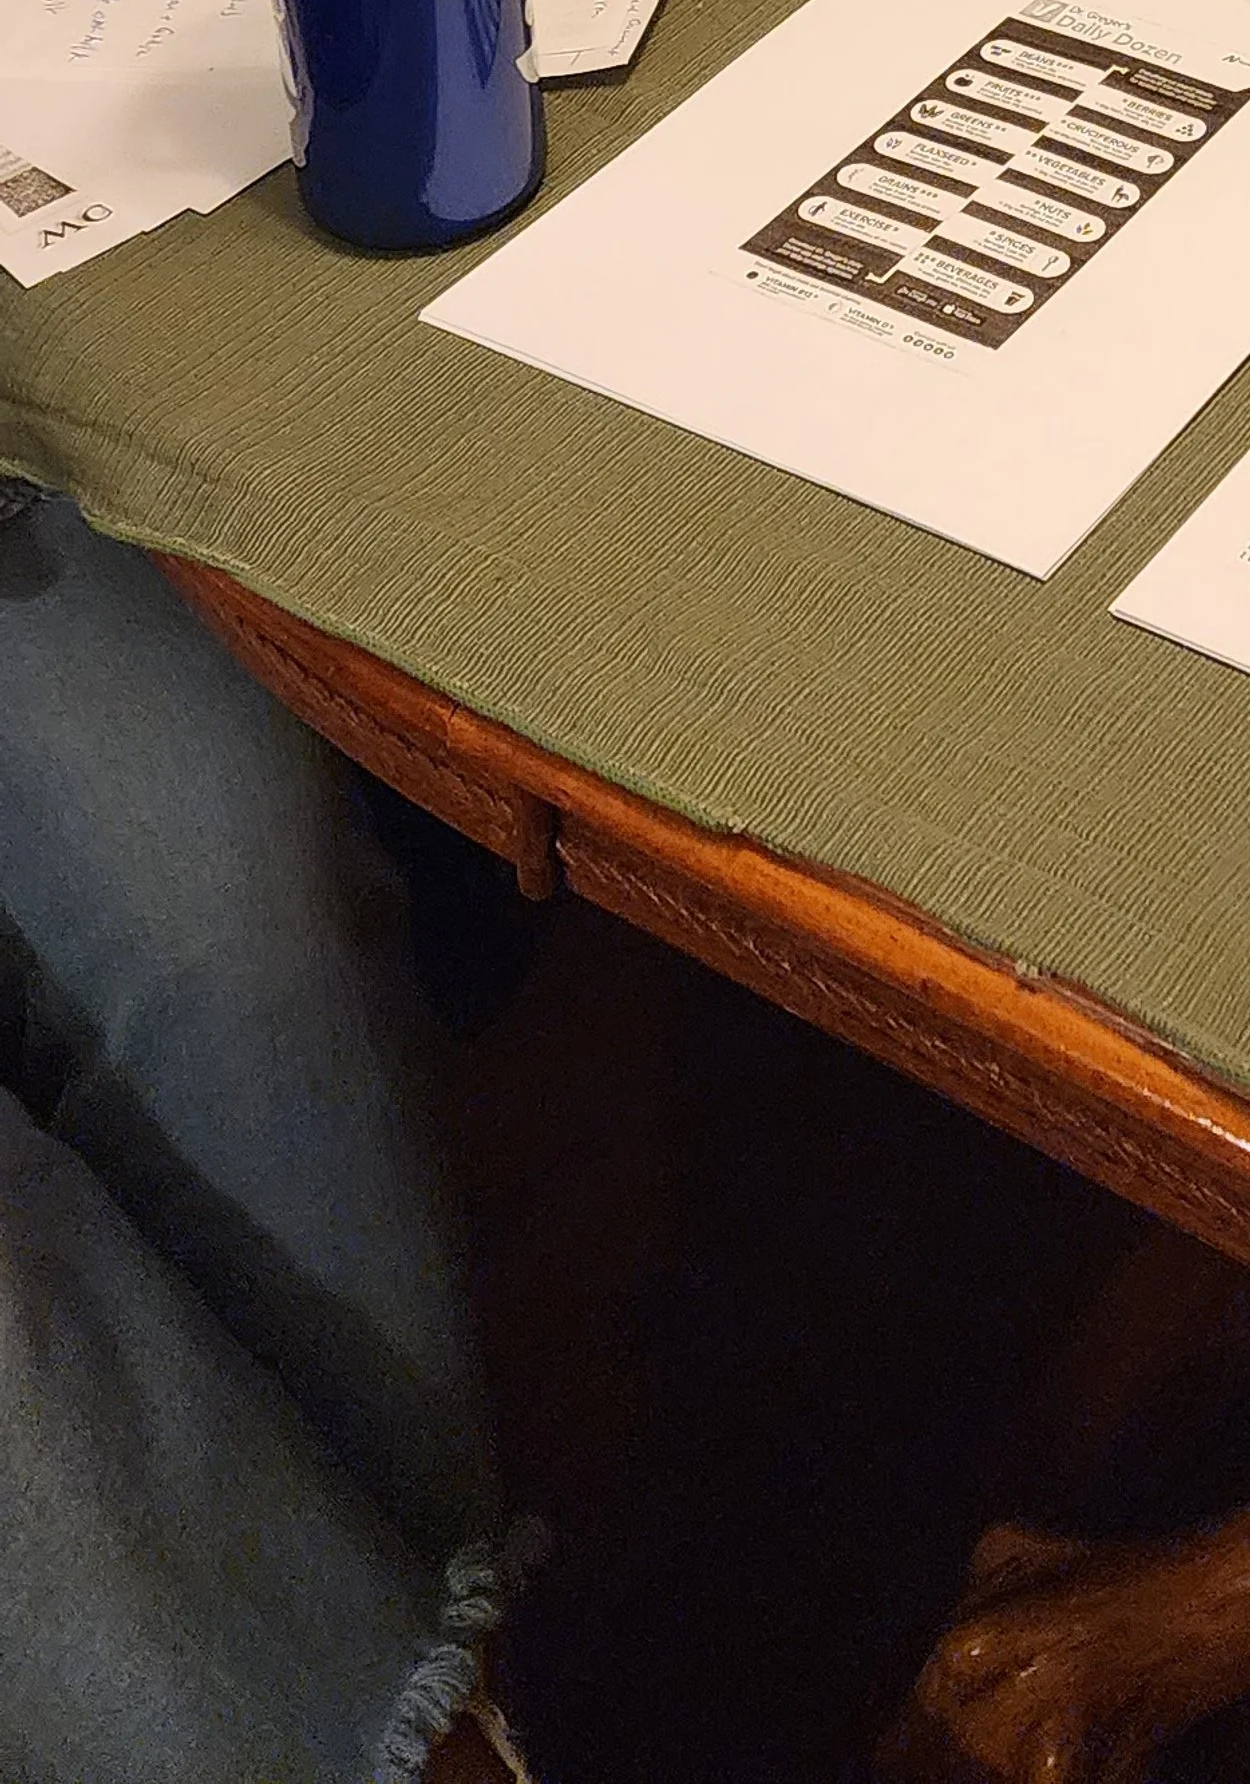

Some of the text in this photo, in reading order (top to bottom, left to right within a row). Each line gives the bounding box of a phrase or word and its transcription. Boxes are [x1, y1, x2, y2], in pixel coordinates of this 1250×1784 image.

[1055, 14, 1183, 64] Daily Dozen
[985, 80, 1023, 97] FRUITS
[950, 111, 994, 130] GREENS
[1065, 121, 1141, 153] CRUCIFEROUS
[914, 142, 971, 166] FLAXSEED
[1036, 154, 1107, 186] VEGETABLES
[839, 208, 892, 231] EXERCISE
[1039, 202, 1072, 219] NUTS
[995, 233, 1036, 254] SPICES
[935, 260, 999, 290] BEVERAGES
